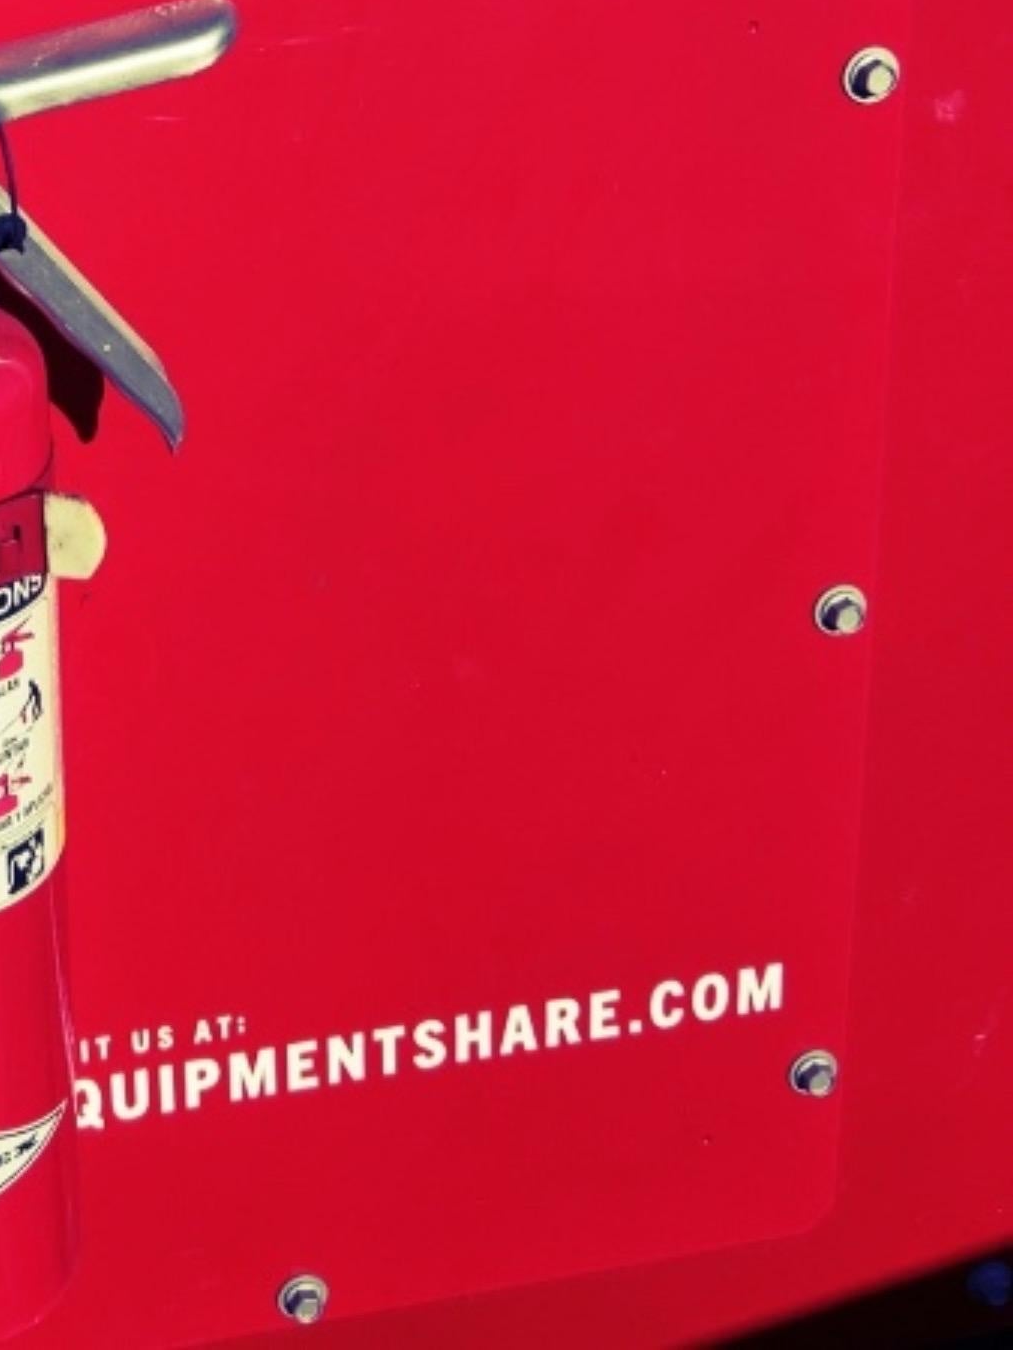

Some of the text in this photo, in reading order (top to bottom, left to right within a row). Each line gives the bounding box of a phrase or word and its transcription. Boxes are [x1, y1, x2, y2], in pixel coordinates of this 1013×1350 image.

[73, 961, 785, 1130] QUIPMENTSHARE.COM
[130, 1023, 175, 1055] US
[193, 1012, 247, 1046] AT:
